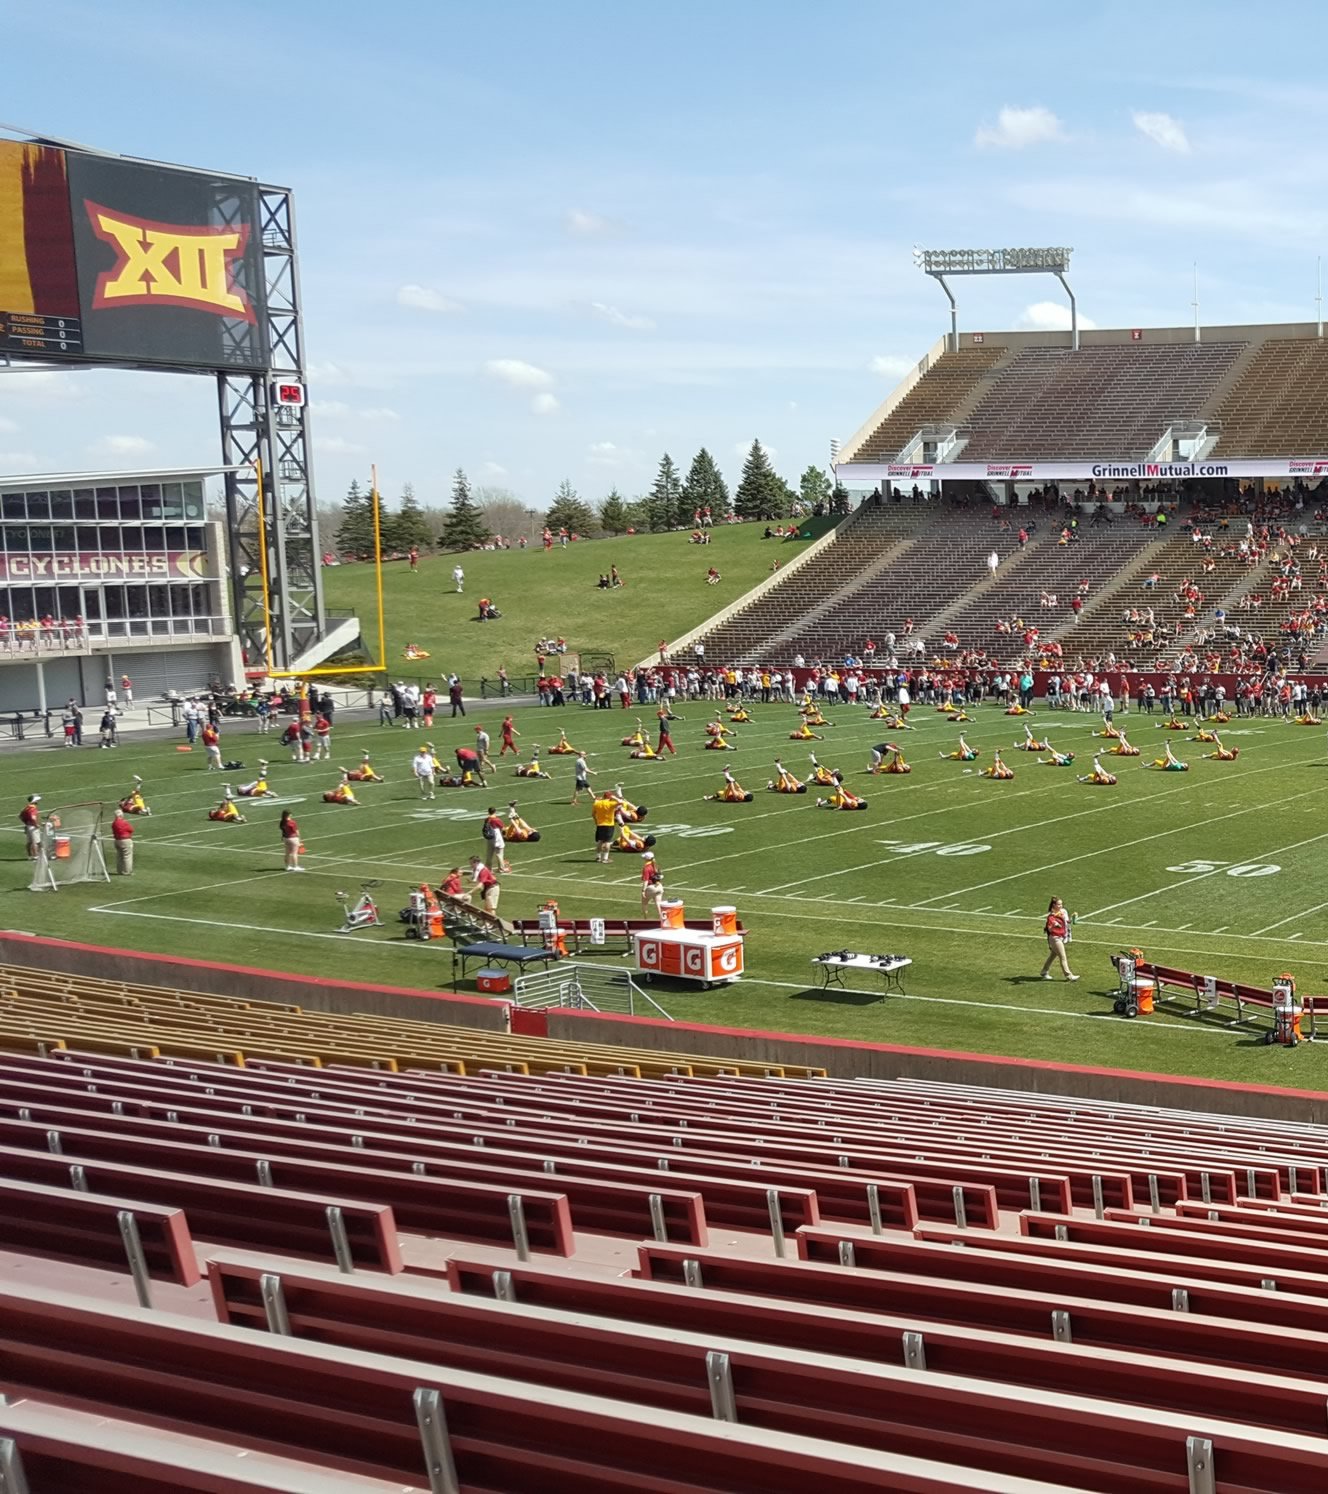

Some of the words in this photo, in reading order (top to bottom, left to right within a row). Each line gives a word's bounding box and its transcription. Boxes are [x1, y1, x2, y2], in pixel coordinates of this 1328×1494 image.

[97, 213, 246, 313] XII
[10, 315, 45, 325] RUSHING
[58, 320, 65, 328] 0
[11, 326, 45, 335] PASSING
[59, 330, 66, 339] 0
[22, 339, 46, 348] TOTAL
[60, 342, 67, 350] 0
[281, 386, 300, 402] 25
[1092, 464, 1228, 477] GrinnellMutual.com
[10, 556, 167, 576] CYCLONES
[715, 917, 721, 926] G
[642, 943, 657, 965] G
[687, 949, 701, 971] G
[721, 948, 737, 971] G
[482, 979, 489, 987] G
